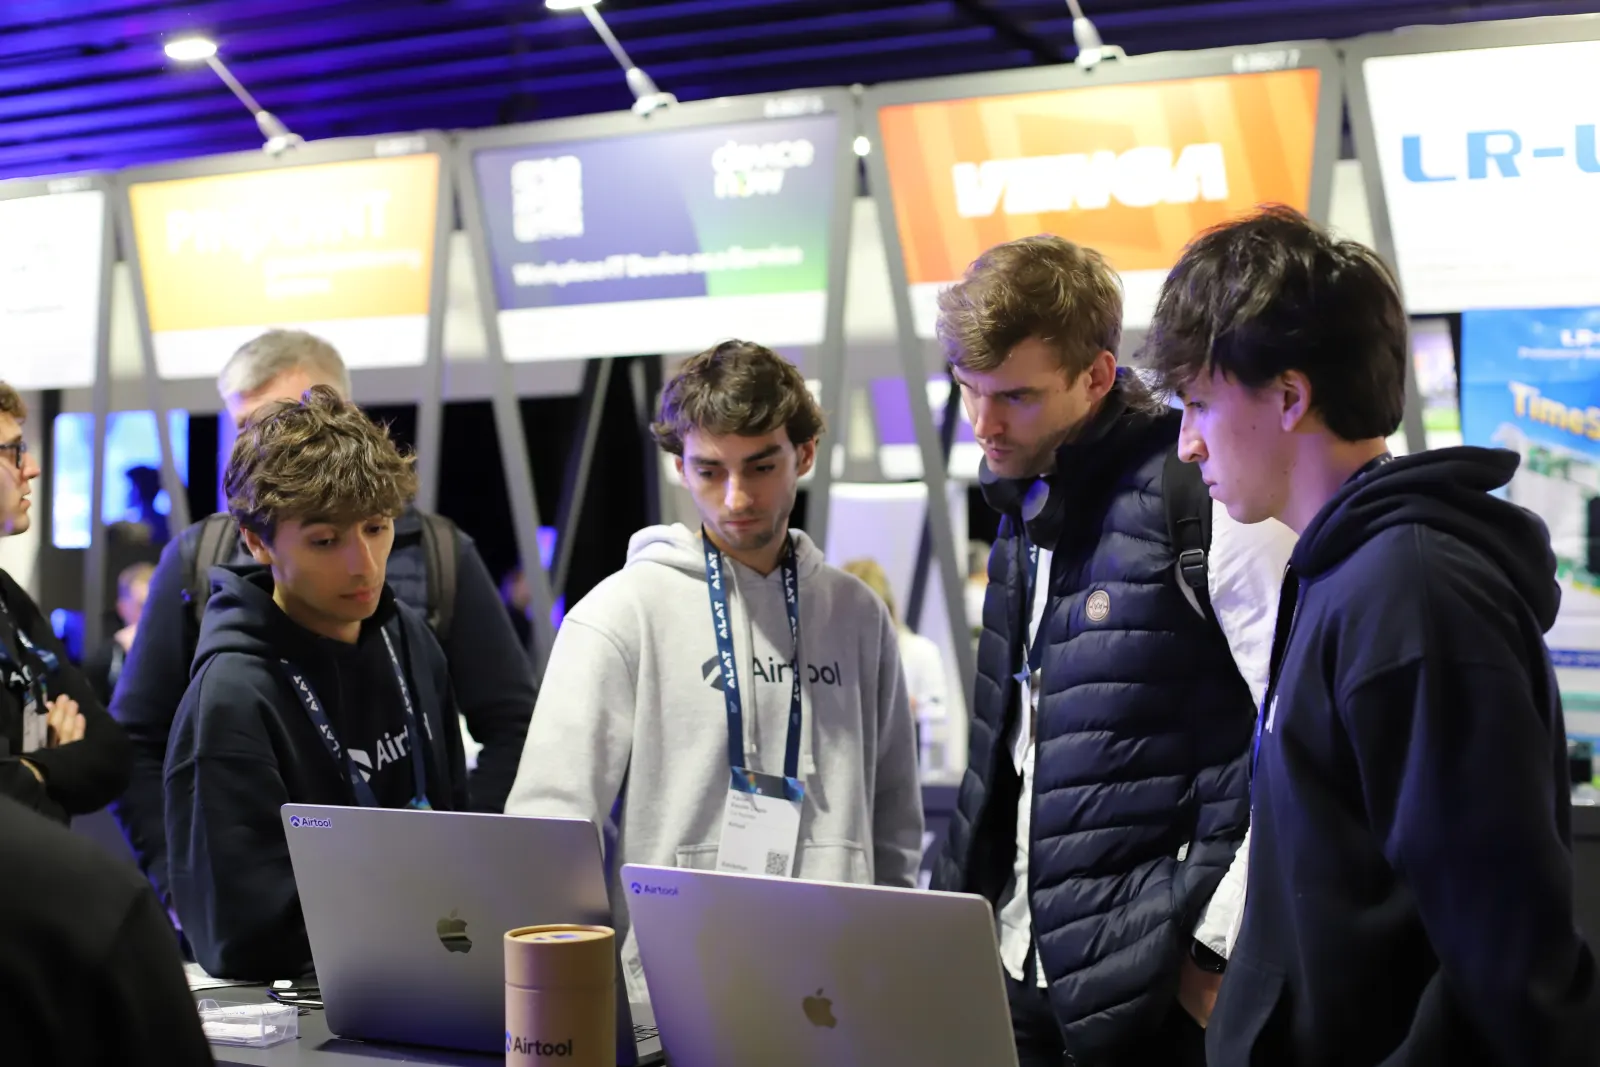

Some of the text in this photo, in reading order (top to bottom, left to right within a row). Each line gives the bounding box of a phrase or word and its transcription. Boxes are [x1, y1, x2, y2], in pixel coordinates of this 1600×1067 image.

[708, 552, 721, 589] ALAT
[785, 567, 795, 603] ALAT
[714, 601, 728, 638] ALAT
[721, 651, 736, 688] ALAT
[293, 675, 319, 711] ALAT
[320, 724, 342, 758] LAT
[301, 817, 332, 828] Airtool
[643, 885, 679, 896] Airtool
[513, 1032, 573, 1057] Airtool
